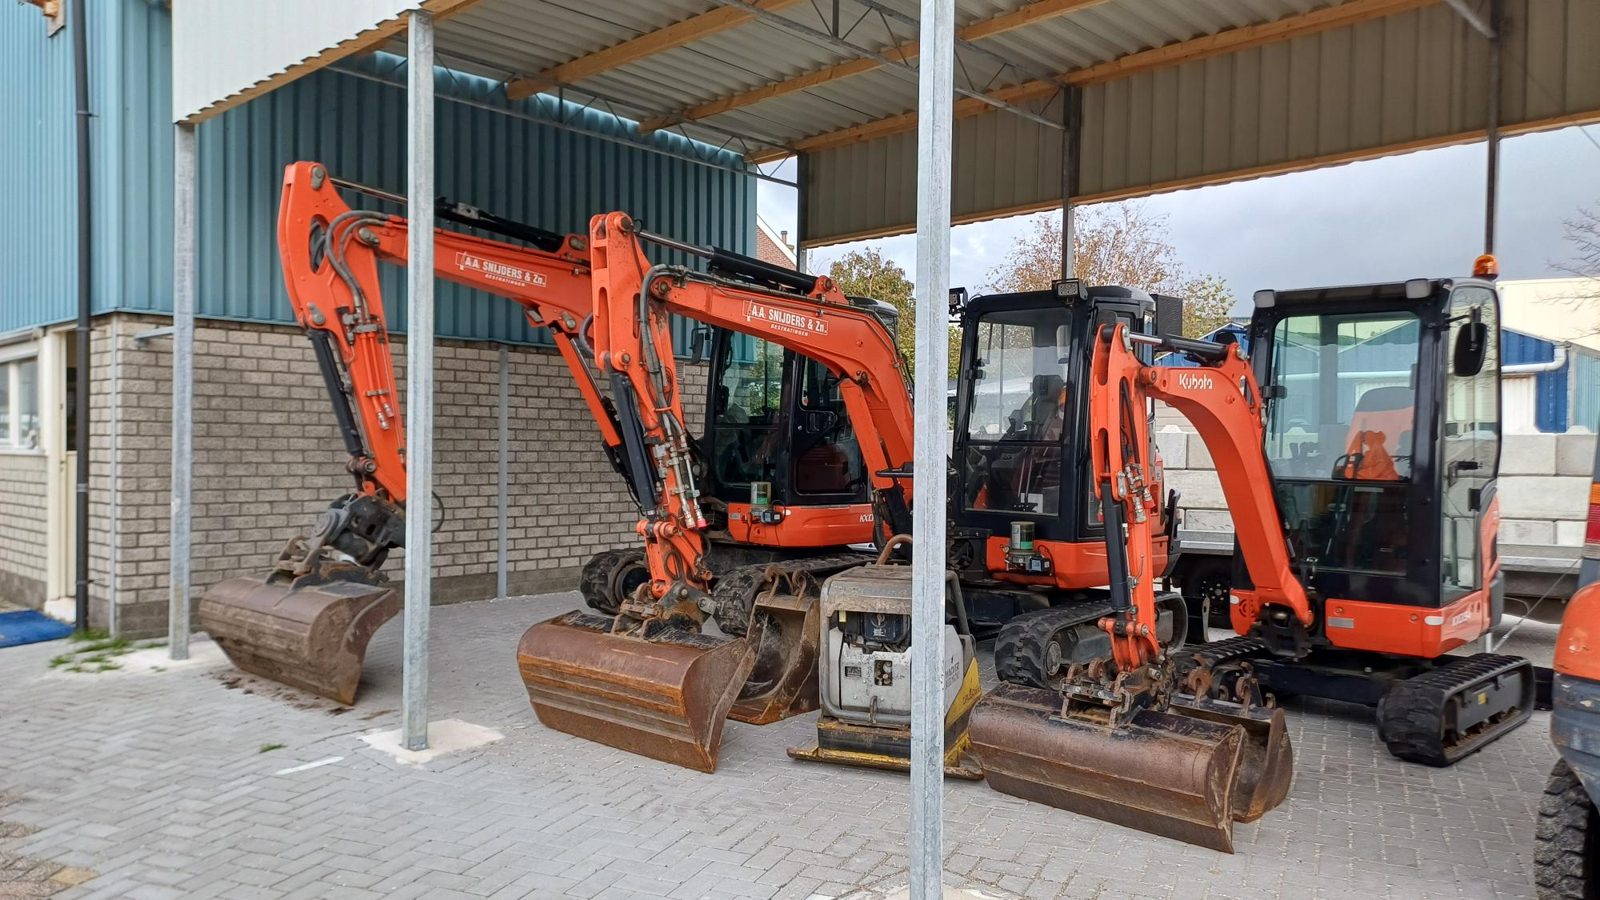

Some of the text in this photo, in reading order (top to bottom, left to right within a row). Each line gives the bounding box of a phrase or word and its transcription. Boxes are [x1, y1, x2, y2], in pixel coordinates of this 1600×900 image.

[482, 260, 523, 280] SNIJDERS
[524, 271, 531, 282] &
[532, 273, 546, 286] Zn.
[768, 308, 806, 328] SNIJDERS
[807, 318, 814, 331] &
[815, 320, 828, 334] Zn.
[1179, 373, 1213, 390] Kubota
